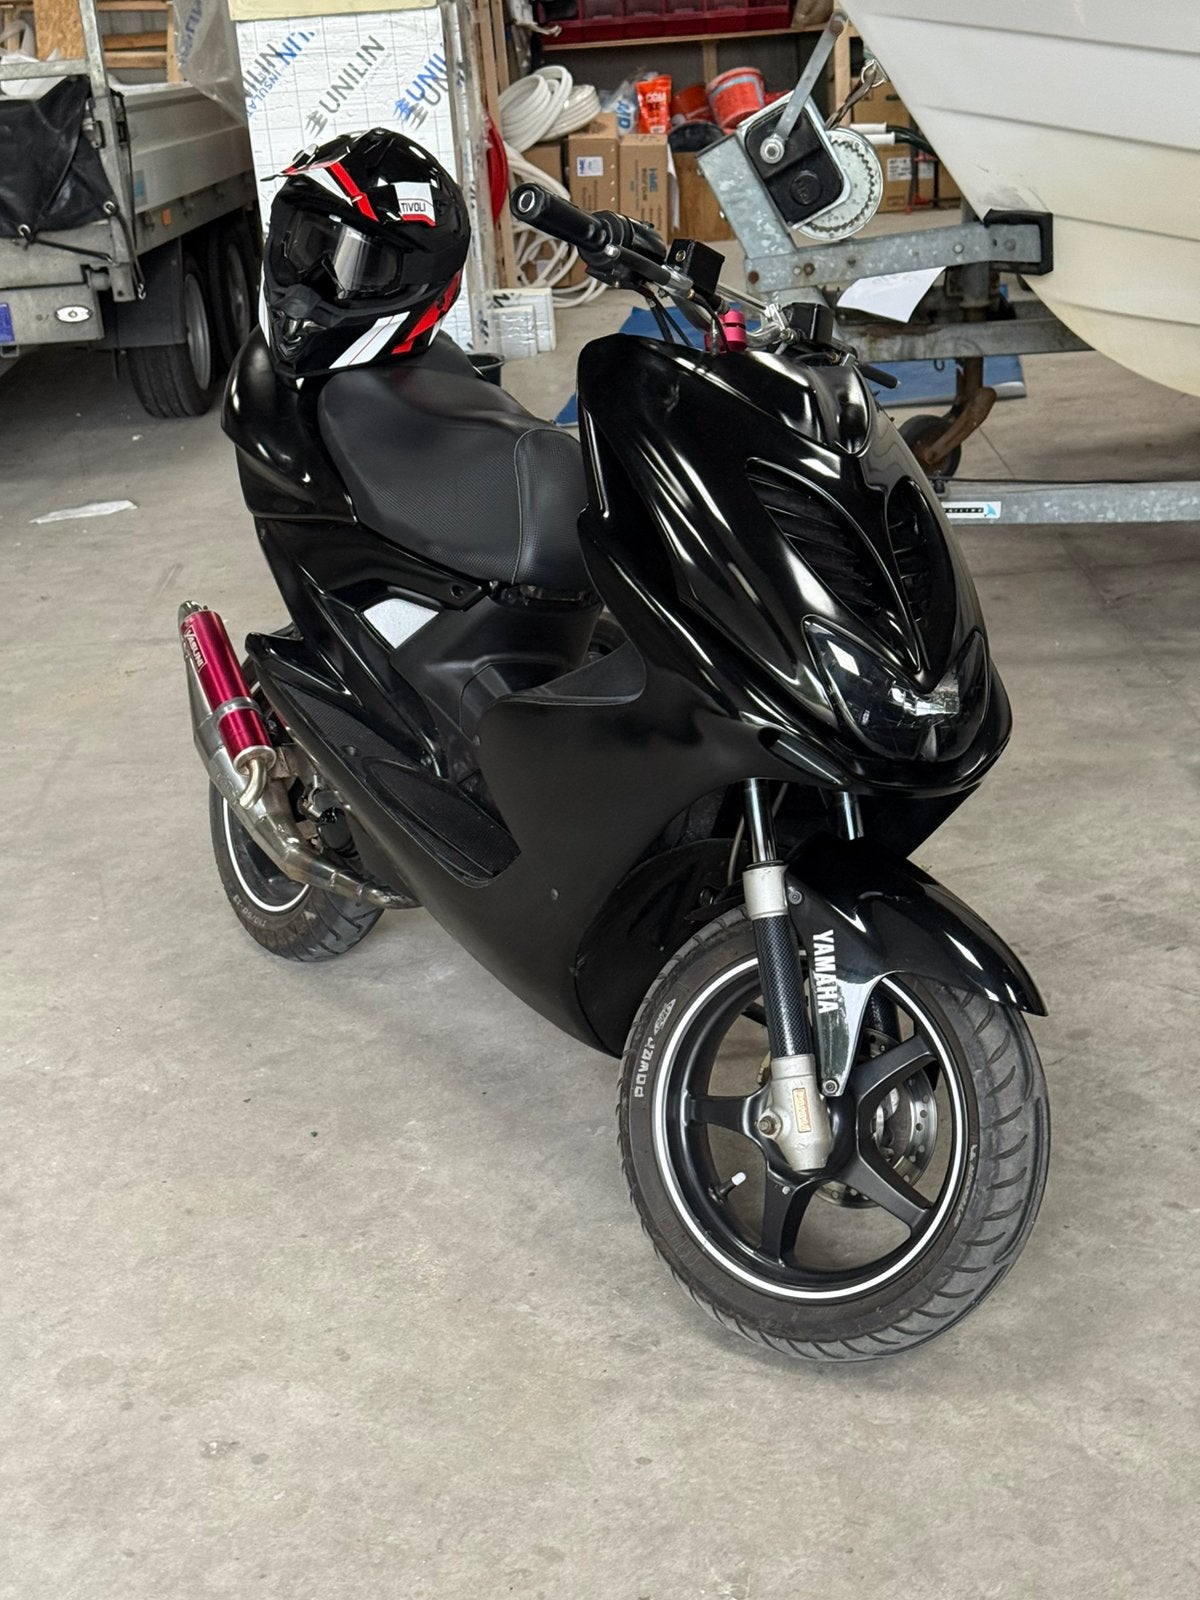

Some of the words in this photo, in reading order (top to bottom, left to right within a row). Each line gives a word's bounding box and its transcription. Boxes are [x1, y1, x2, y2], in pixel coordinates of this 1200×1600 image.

[318, 34, 385, 113] UNILIN
[400, 202, 427, 212] TIVOLI
[184, 628, 205, 668] YASUNI
[812, 928, 840, 1015] YAMAHA
